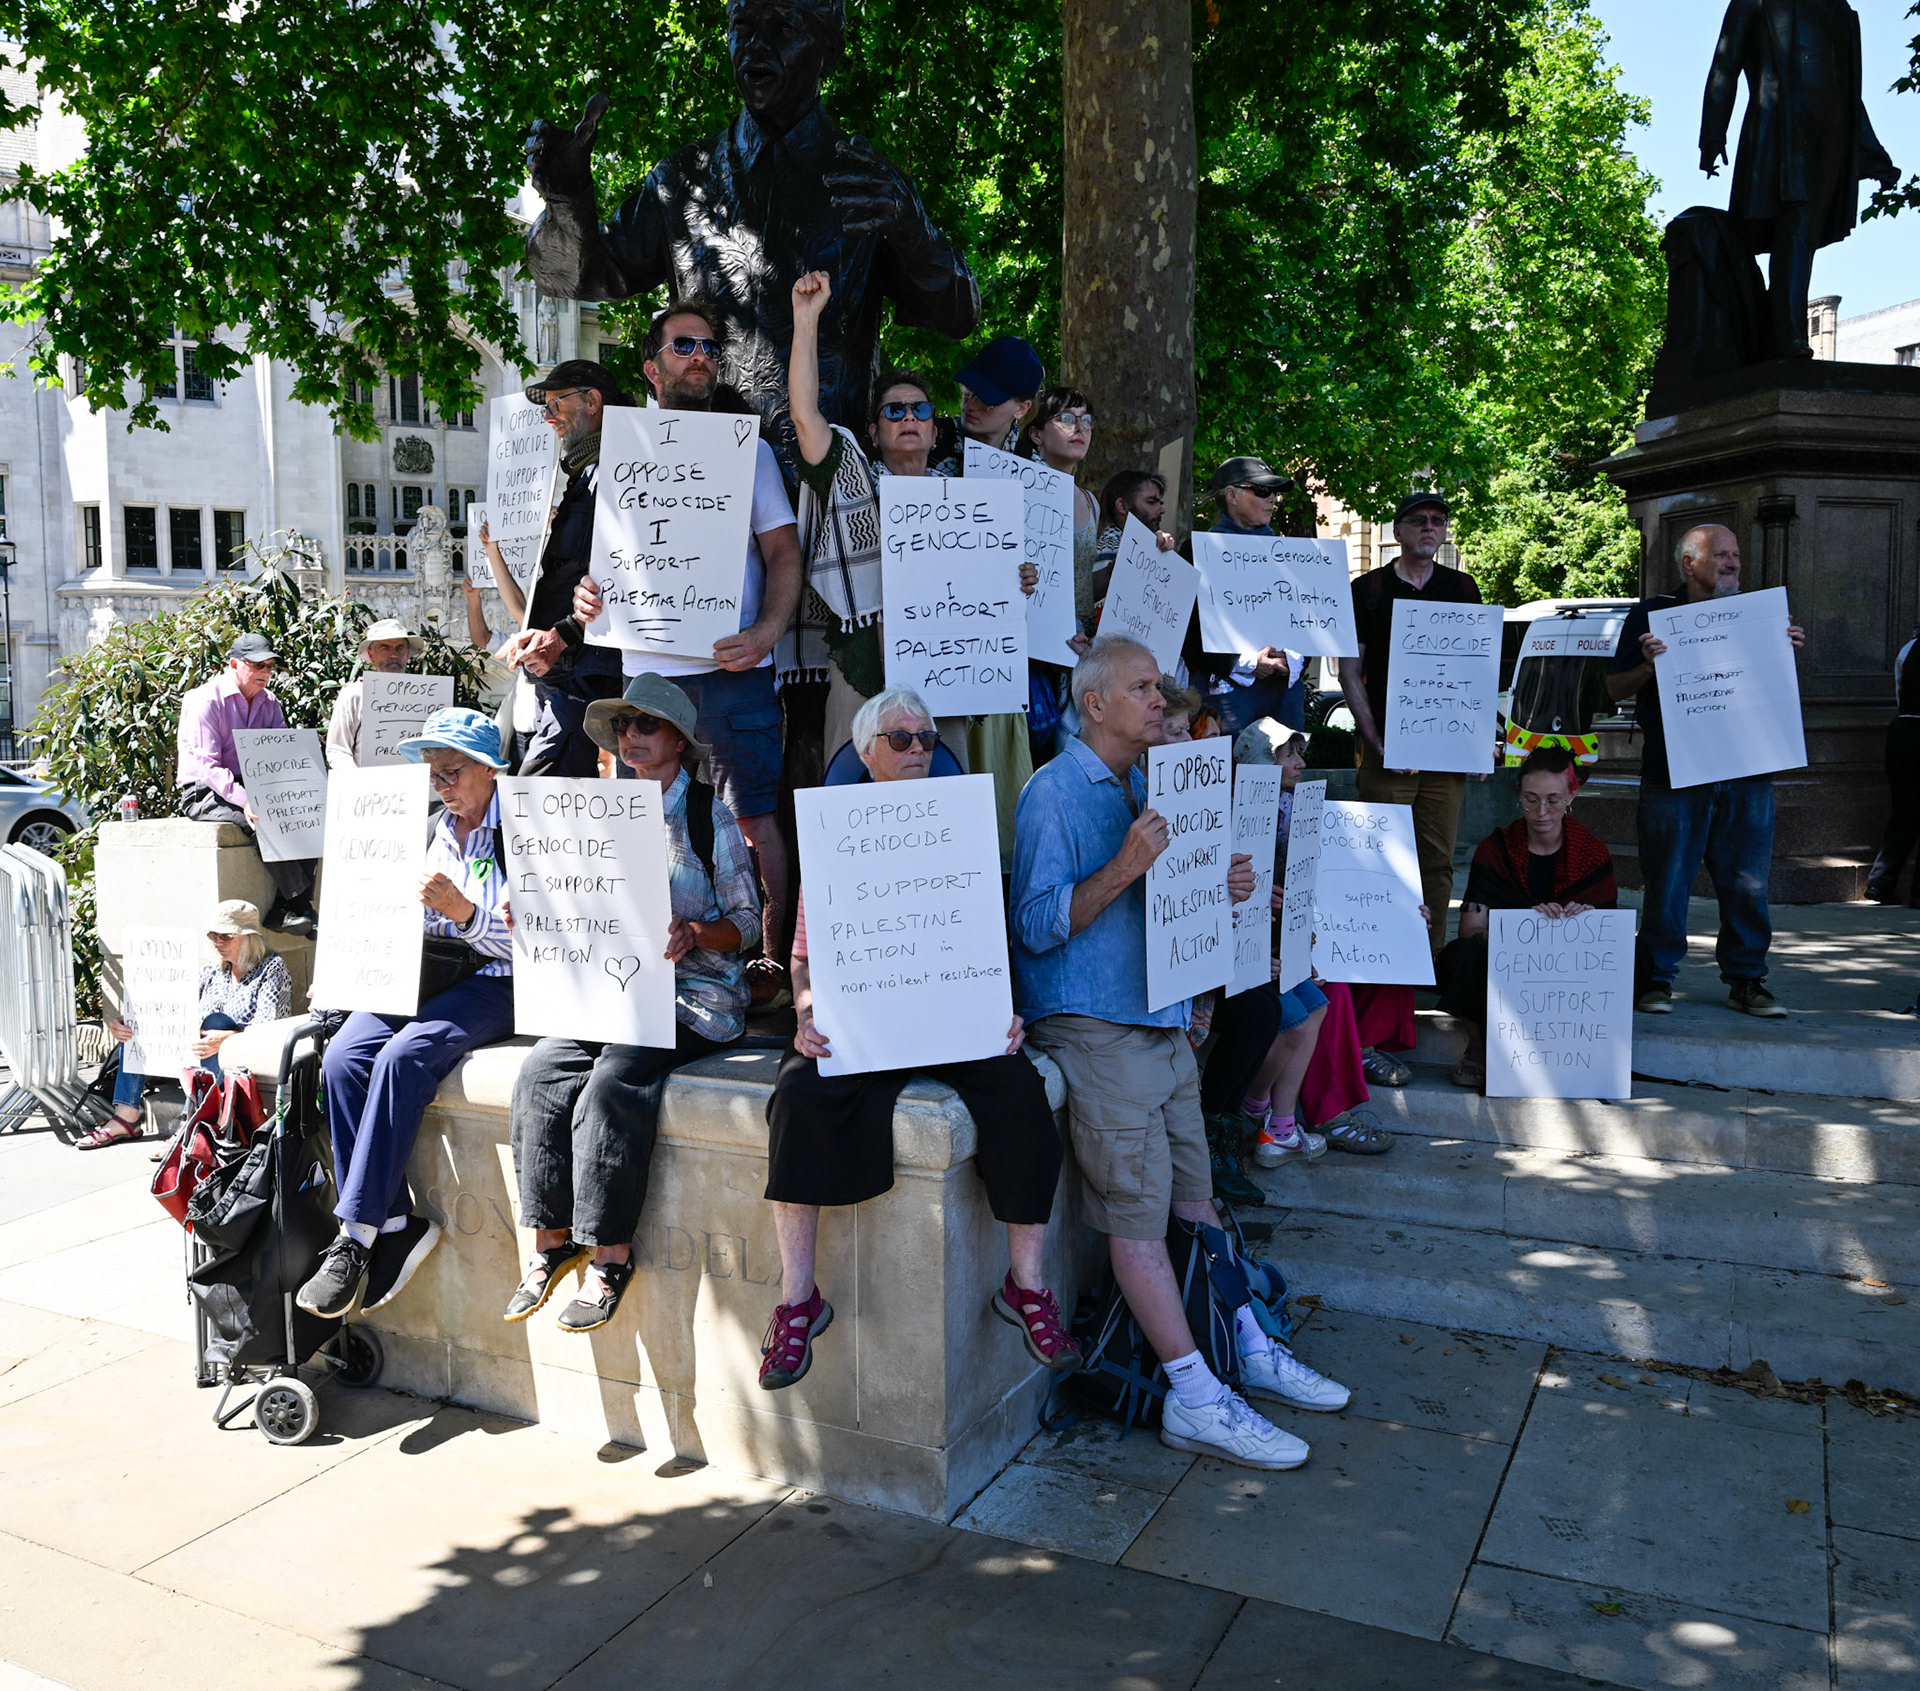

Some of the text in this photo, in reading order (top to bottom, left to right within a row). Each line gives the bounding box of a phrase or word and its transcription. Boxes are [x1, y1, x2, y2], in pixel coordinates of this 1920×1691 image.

[658, 419, 680, 445] I
[496, 434, 548, 461] GENOCIDE
[968, 446, 982, 468] I
[505, 465, 547, 487] SUPPORT
[613, 461, 706, 484] OPPOSE
[497, 489, 542, 508] PALESTINE
[618, 487, 731, 511] GENOCIDE
[942, 478, 949, 500] I
[502, 511, 541, 528] ACTION
[888, 502, 994, 524] OPPOSE
[1024, 499, 1071, 541] CIDE
[648, 519, 671, 545] I
[479, 546, 528, 559] SPORT
[887, 531, 1018, 562] GENOCIDE
[1126, 538, 1138, 565] I
[1270, 540, 1333, 565] Genocide
[472, 563, 528, 580] PALINE
[599, 577, 737, 611] PALESTINE ACTION
[946, 581, 955, 600] I
[1273, 580, 1338, 608] Palestine
[904, 600, 1010, 620] SUPPORT
[1112, 593, 1123, 618] I
[1290, 613, 1337, 630] Action
[1406, 609, 1488, 628] I OPPOSE
[1666, 615, 1683, 635] I
[895, 636, 1018, 661] PALESTINE
[1401, 633, 1492, 652] GENOCIDE
[1532, 639, 1611, 651] POLICE POLICE
[1679, 633, 1728, 647] GENOCIDE
[924, 665, 1013, 688] ACTION
[1435, 663, 1446, 676] I
[1674, 672, 1692, 686] I
[371, 679, 438, 697] I OPPOSE
[1403, 678, 1472, 692] SUPPORT
[1399, 695, 1484, 711] PALESTINE
[1686, 704, 1727, 716] ACTION
[375, 728, 387, 739] I
[1400, 717, 1475, 736] ACTION
[239, 733, 297, 749] I OPPOSE
[244, 757, 312, 779] GENOCIDE
[1155, 754, 1227, 797] I OPPOSE
[266, 789, 319, 805] SUPPORT
[1239, 780, 1245, 806] I
[266, 803, 324, 822] PALESTINE
[353, 792, 408, 818] OPPOSE
[513, 792, 647, 820] I OPPOSE
[819, 799, 939, 830] I OPPOSE
[279, 818, 321, 835] ACTION
[1167, 808, 1224, 841] NOCIDE
[511, 834, 617, 859] GENOCIDE
[836, 827, 952, 857] GENOCIDE
[1320, 835, 1386, 858] enocide
[519, 872, 539, 893] I
[856, 872, 981, 901] SUPPORT
[1152, 884, 1227, 927] PALESTINE
[1345, 889, 1393, 909] support
[524, 912, 620, 934] PALESTINE
[830, 909, 963, 941] PALESTINE
[1312, 912, 1380, 933] Palestine
[1517, 915, 1617, 945] OPPOSE
[533, 944, 592, 964] ACTION
[836, 940, 954, 967] ACTION in
[1169, 918, 1220, 970] ACTION
[1331, 941, 1391, 965] Action
[1494, 951, 1618, 982] GENOCIDE
[840, 966, 1003, 994] non-violent resistance
[1516, 989, 1615, 1014] SUPPORT
[1497, 1022, 1609, 1042] PALESTINE
[1510, 1050, 1591, 1069] ACTION
[633, 1222, 783, 1289] NDEL
